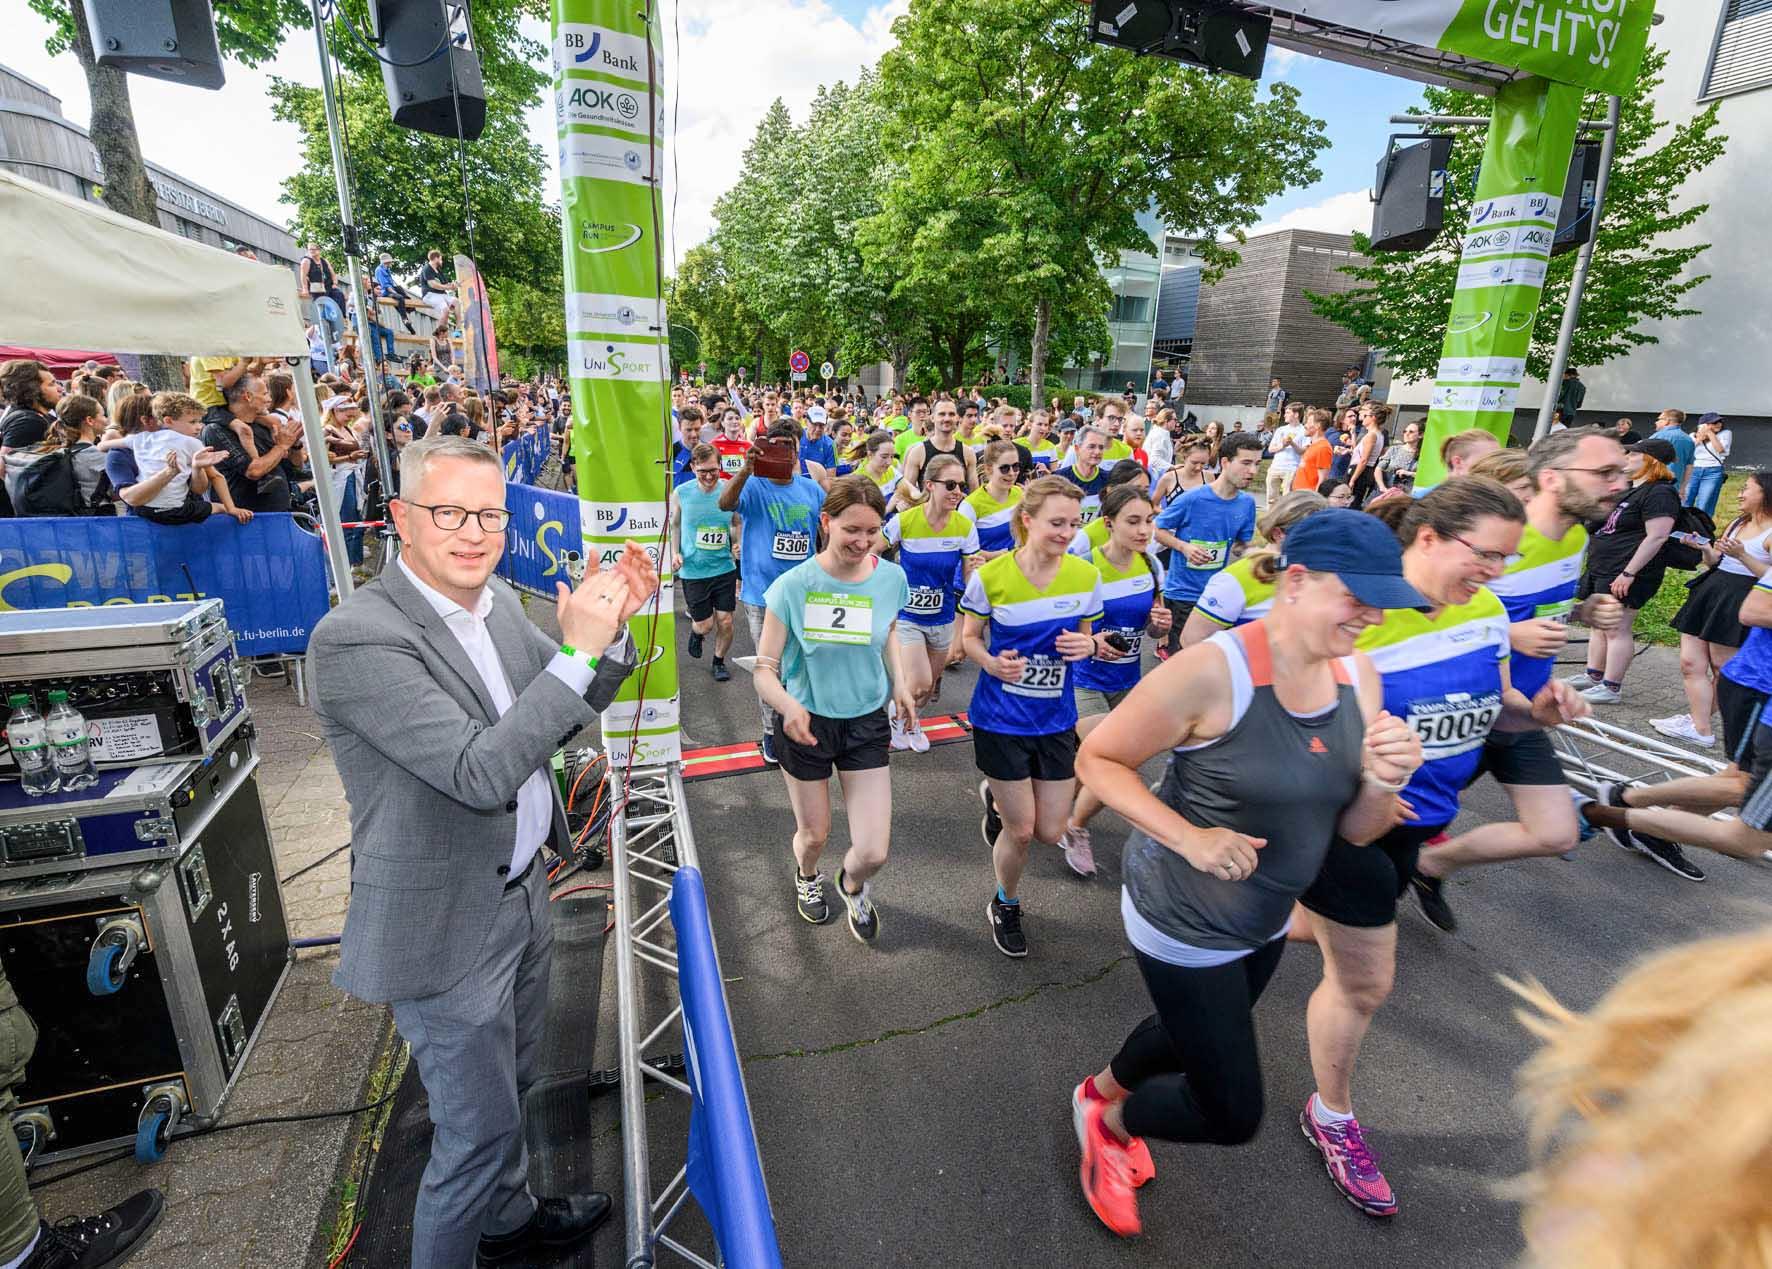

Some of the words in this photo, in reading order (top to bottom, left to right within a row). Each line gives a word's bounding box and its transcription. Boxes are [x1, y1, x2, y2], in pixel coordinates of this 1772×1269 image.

[565, 33, 584, 48] BB
[602, 50, 638, 72] Bank
[568, 88, 615, 111] AOK
[1529, 198, 1543, 208] BB
[1473, 206, 1484, 216] BB
[1491, 207, 1517, 219] Bank
[1466, 233, 1493, 250] AOK
[1522, 230, 1544, 244] AOK
[726, 459, 741, 468] 463
[597, 510, 614, 521] BB
[629, 517, 659, 530] Bank
[702, 533, 723, 543] 412
[776, 538, 808, 553] 5306
[831, 607, 846, 629] 2
[236, 626, 305, 641] t.fu-berlin.de
[1022, 667, 1062, 686] 225
[1417, 709, 1493, 742] 5009
[217, 902, 228, 922] 2
